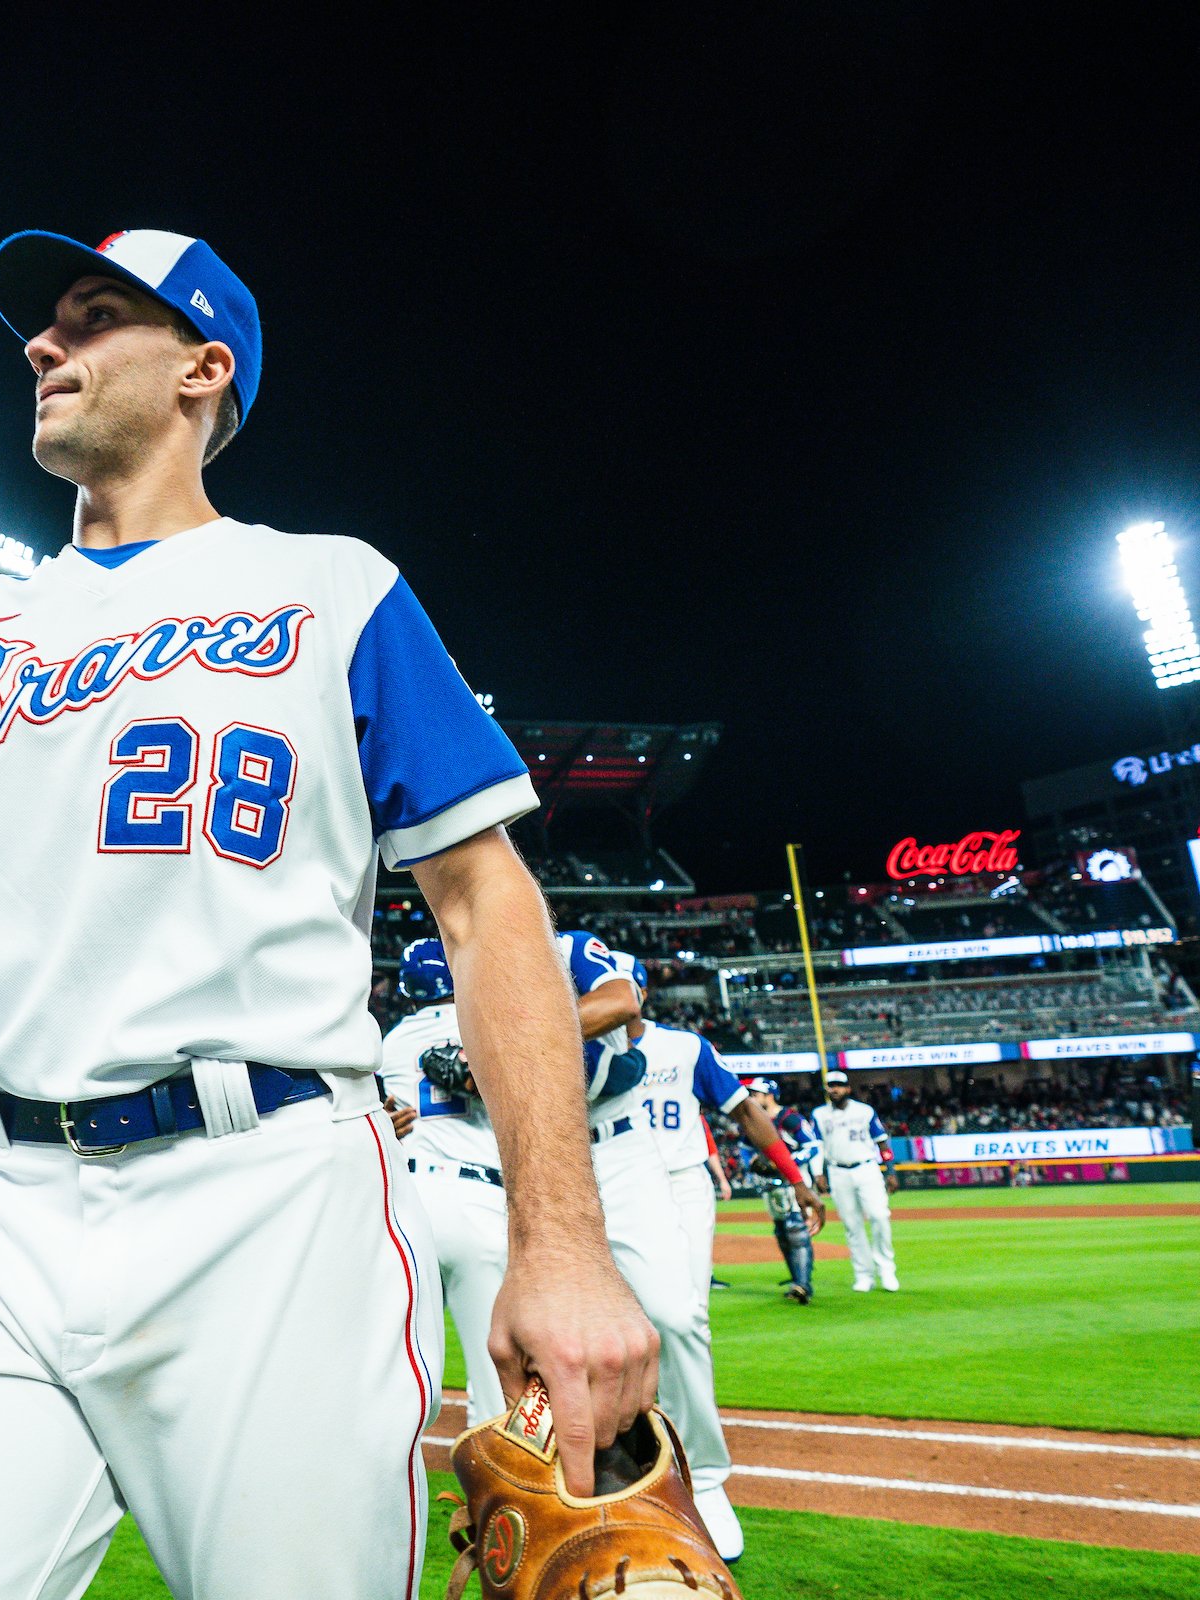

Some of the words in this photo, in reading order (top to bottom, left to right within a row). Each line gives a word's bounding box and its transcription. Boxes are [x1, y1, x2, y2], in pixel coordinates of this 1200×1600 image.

[97, 716, 298, 870] 28
[885, 829, 1021, 880] Coca-Cola
[907, 947, 959, 959] BRAVES
[963, 944, 990, 954] WIN
[871, 1052, 925, 1064] BRAVES
[930, 1050, 958, 1060] WIN
[1055, 1042, 1112, 1054] BRAVES
[1117, 1040, 1147, 1050] WIN
[641, 1098, 681, 1130] 18
[973, 1139, 1058, 1157] BRAVES
[1064, 1137, 1110, 1153] WIN
